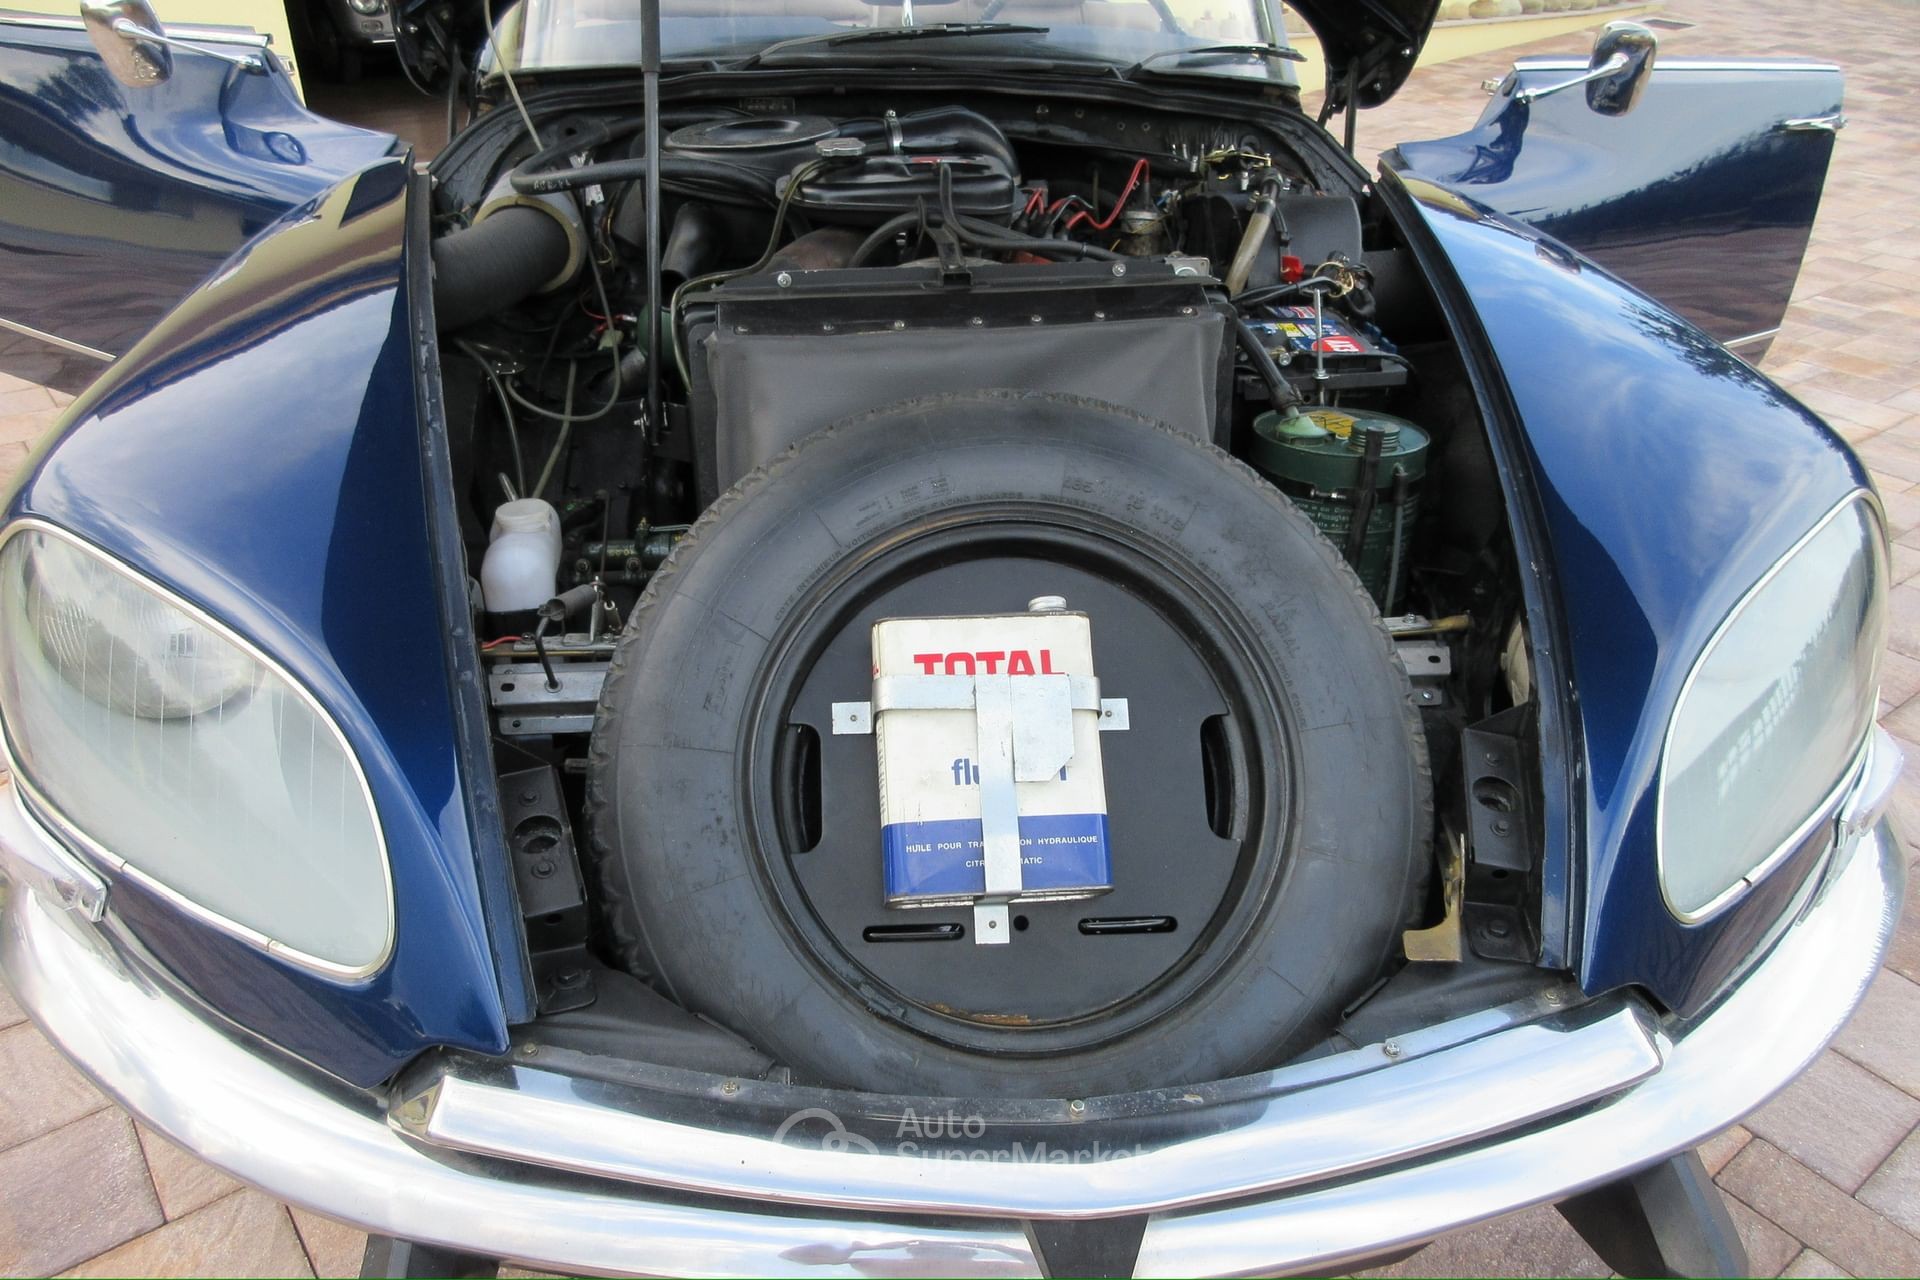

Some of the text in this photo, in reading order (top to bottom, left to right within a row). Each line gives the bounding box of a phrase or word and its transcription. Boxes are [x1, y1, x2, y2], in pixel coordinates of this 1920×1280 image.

[914, 650, 1066, 675] TOTAL
[906, 844, 932, 853] HUILE
[938, 842, 962, 850] POUR
[1038, 835, 1098, 844] HYDRAULIQUE
